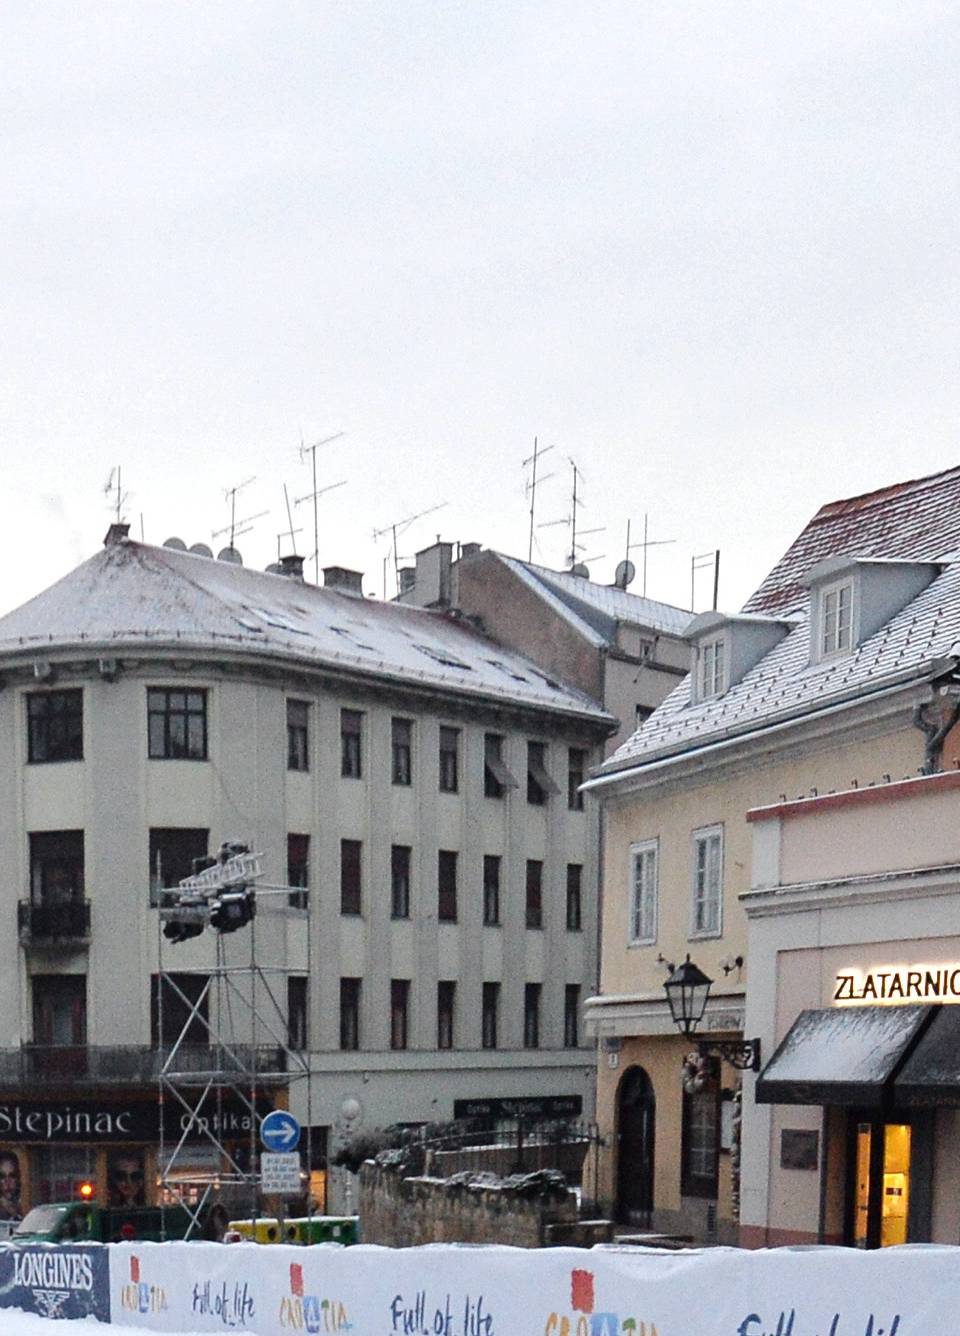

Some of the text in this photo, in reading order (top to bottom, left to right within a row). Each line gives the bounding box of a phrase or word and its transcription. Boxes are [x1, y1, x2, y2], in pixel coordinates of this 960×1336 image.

[0, 1106, 251, 1138] Stepinac Optika
[13, 1252, 93, 1290] LONGINES
[390, 1290, 429, 1336] Full
